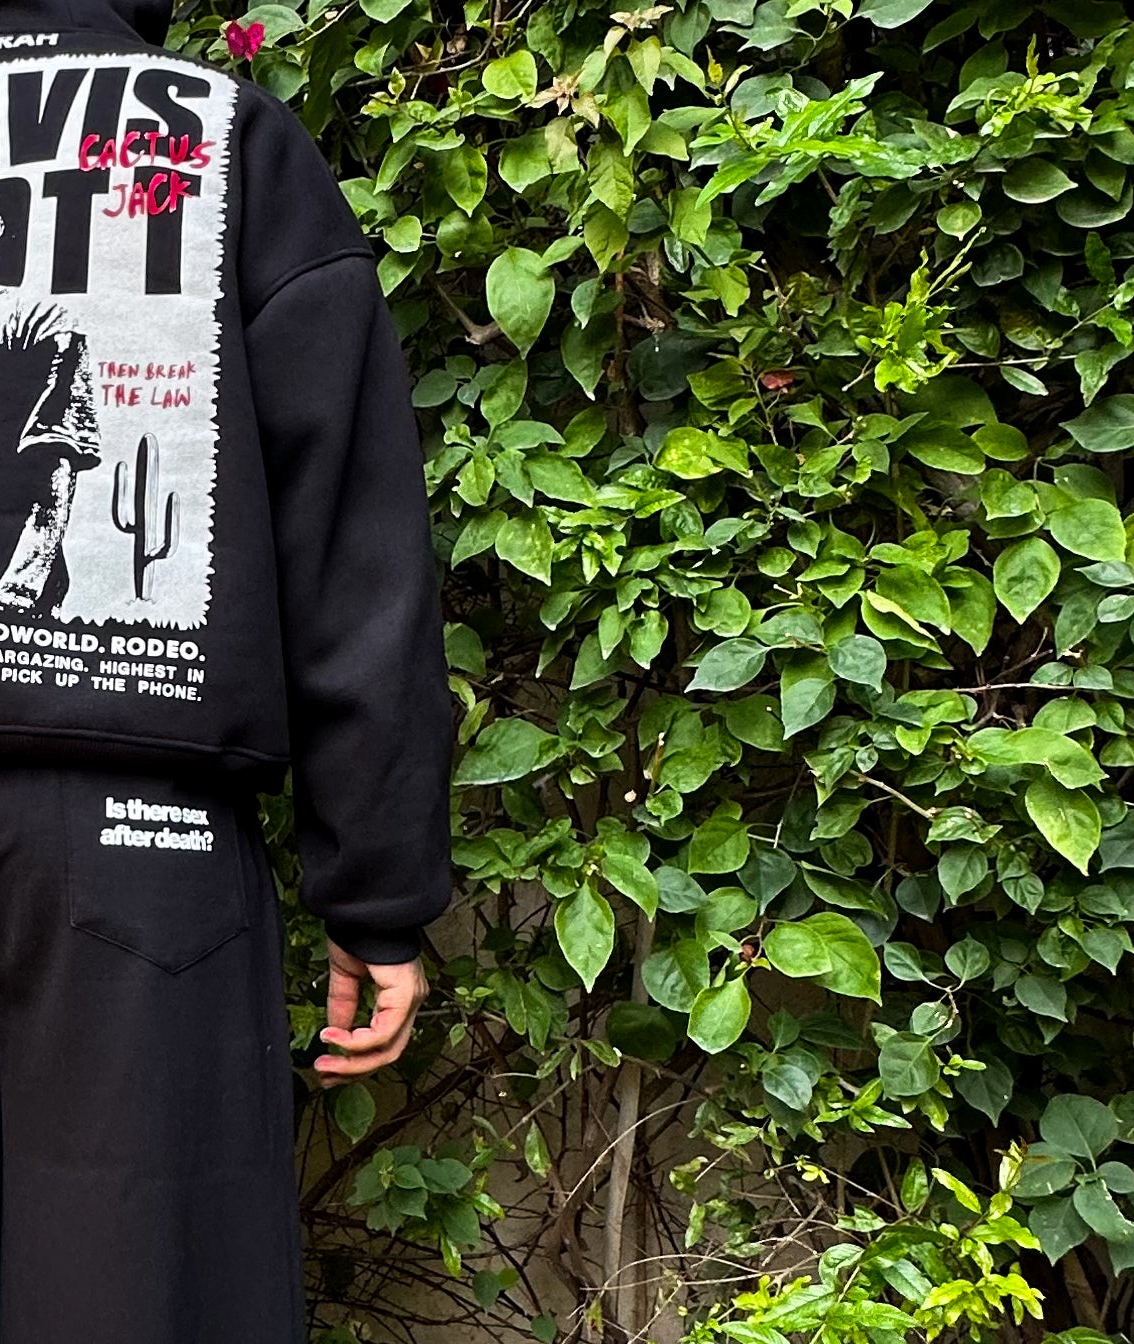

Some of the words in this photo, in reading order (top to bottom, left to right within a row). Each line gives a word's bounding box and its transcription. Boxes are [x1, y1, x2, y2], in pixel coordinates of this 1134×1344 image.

[79, 130, 217, 171] CACTUS
[103, 171, 192, 219] JACK
[98, 361, 140, 379] THEN
[144, 360, 196, 381] BREAK
[101, 383, 143, 408] THE
[150, 386, 191, 409] LAW
[110, 636, 206, 662] RODEO.
[1, 668, 43, 684] PICK
[55, 673, 80, 688] UP
[91, 676, 126, 693] THE
[137, 680, 203, 702] PHONE.
[99, 660, 177, 680] HIGHEST
[187, 668, 205, 684] IN
[106, 797, 126, 819] Is
[127, 798, 182, 823] there
[182, 808, 209, 826] sex
[100, 824, 155, 848] after
[155, 827, 214, 852] death?
